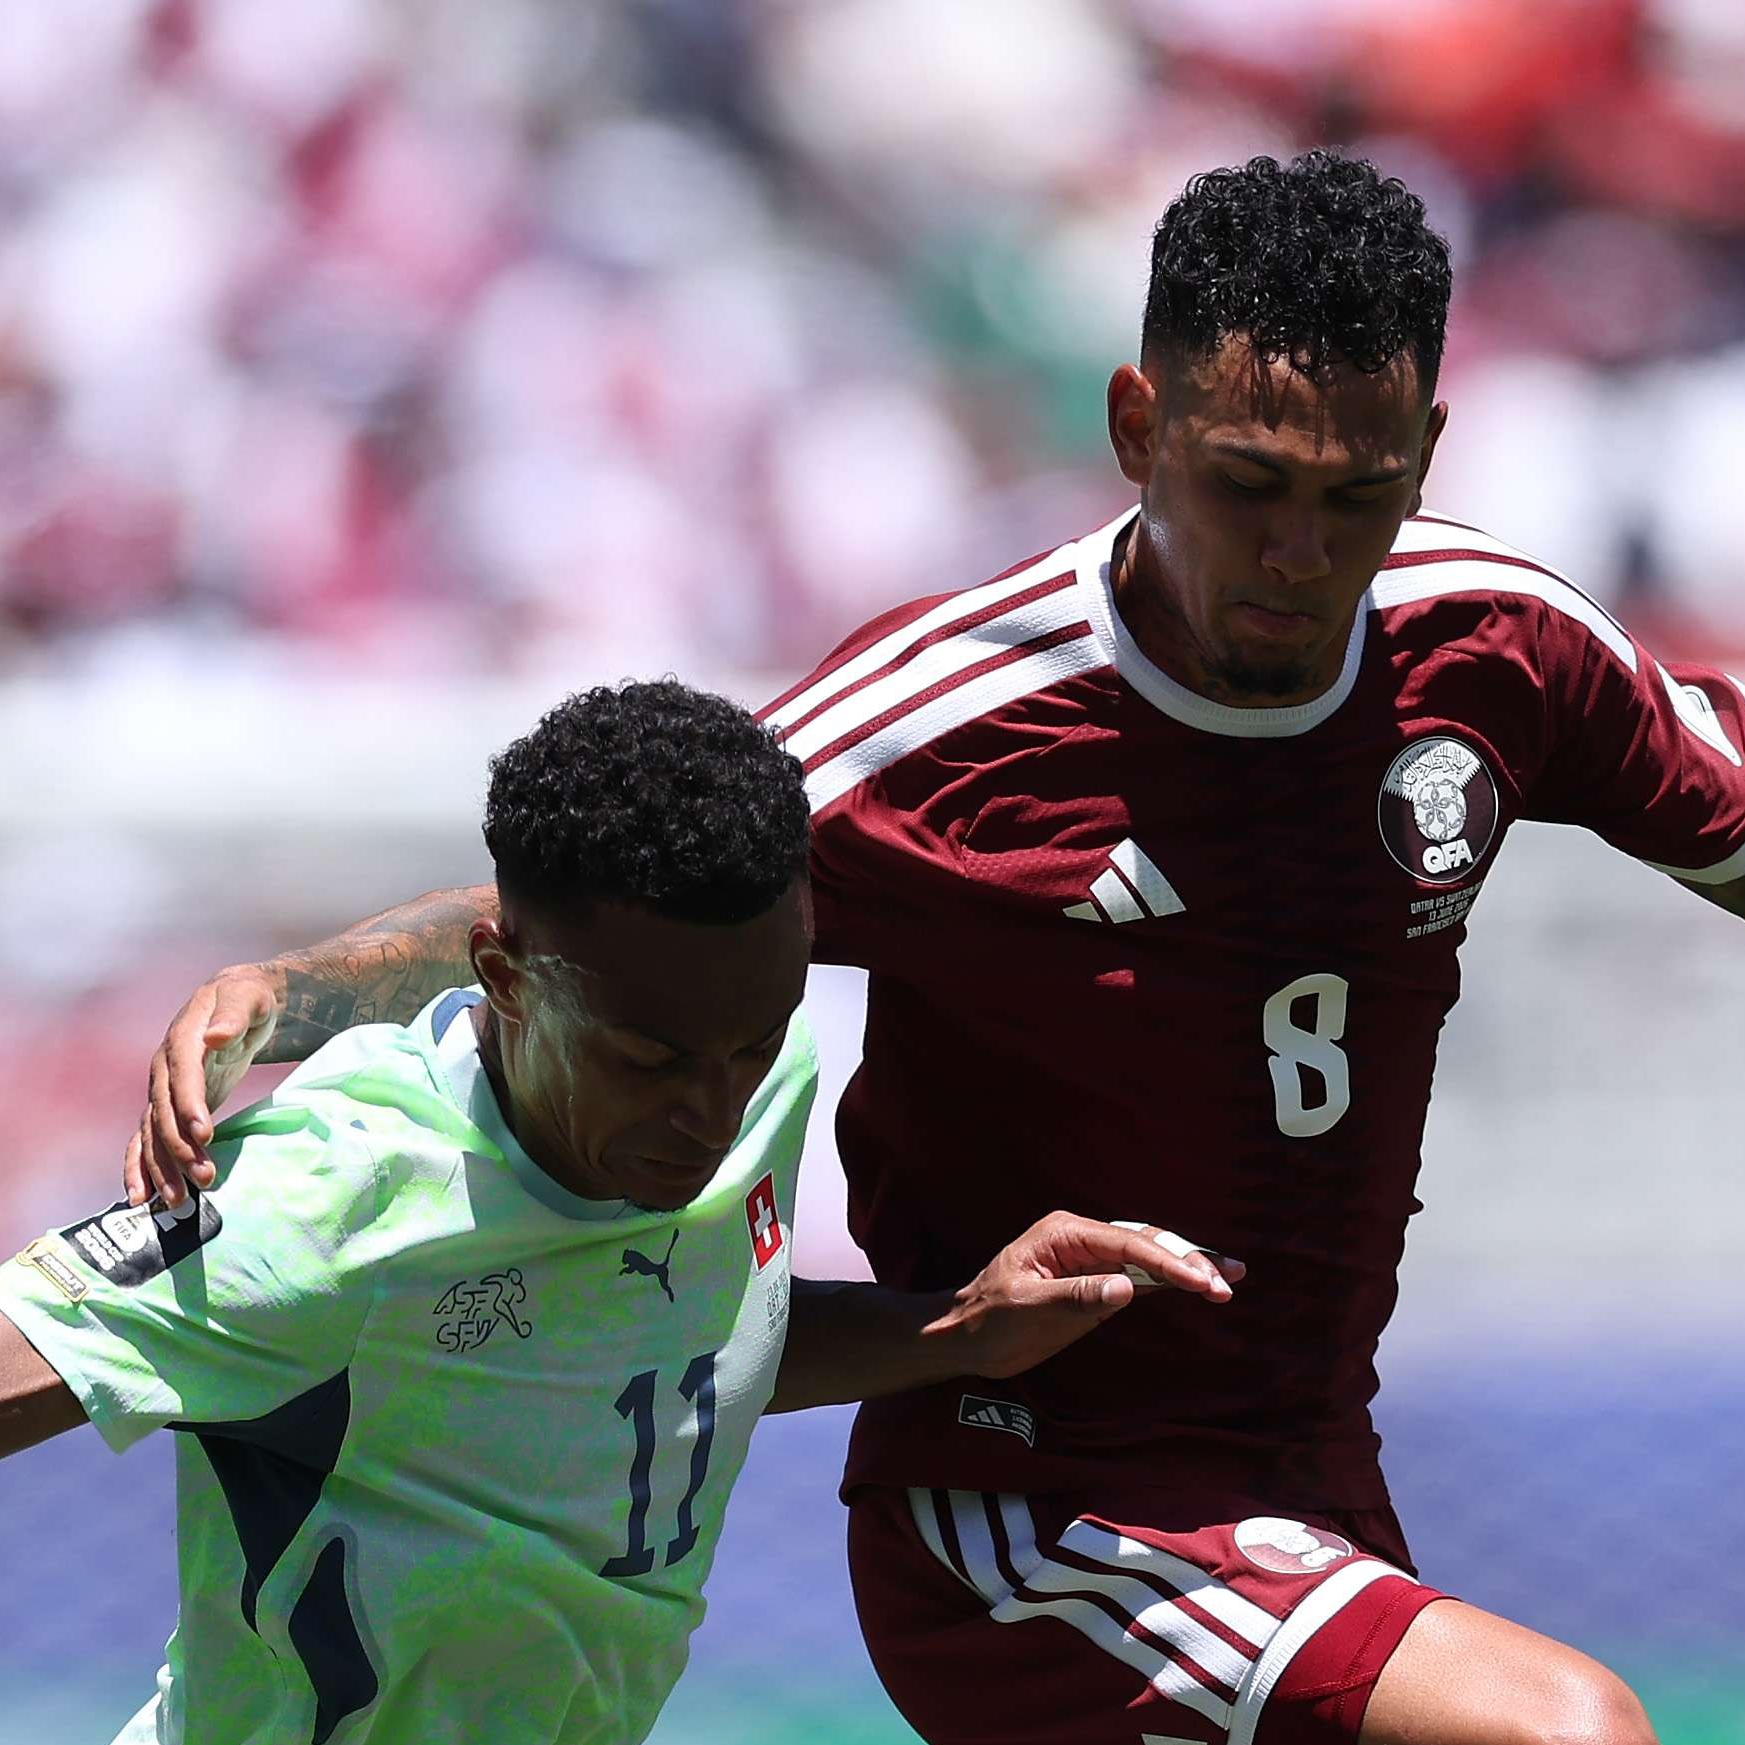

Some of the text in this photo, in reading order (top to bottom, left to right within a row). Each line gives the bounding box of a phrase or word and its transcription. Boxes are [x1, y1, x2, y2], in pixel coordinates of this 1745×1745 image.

[1422, 838, 1474, 875] QFA
[1263, 973, 1350, 1137] 8
[112, 1219, 132, 1242] FIFA
[598, 1351, 717, 1578] 11
